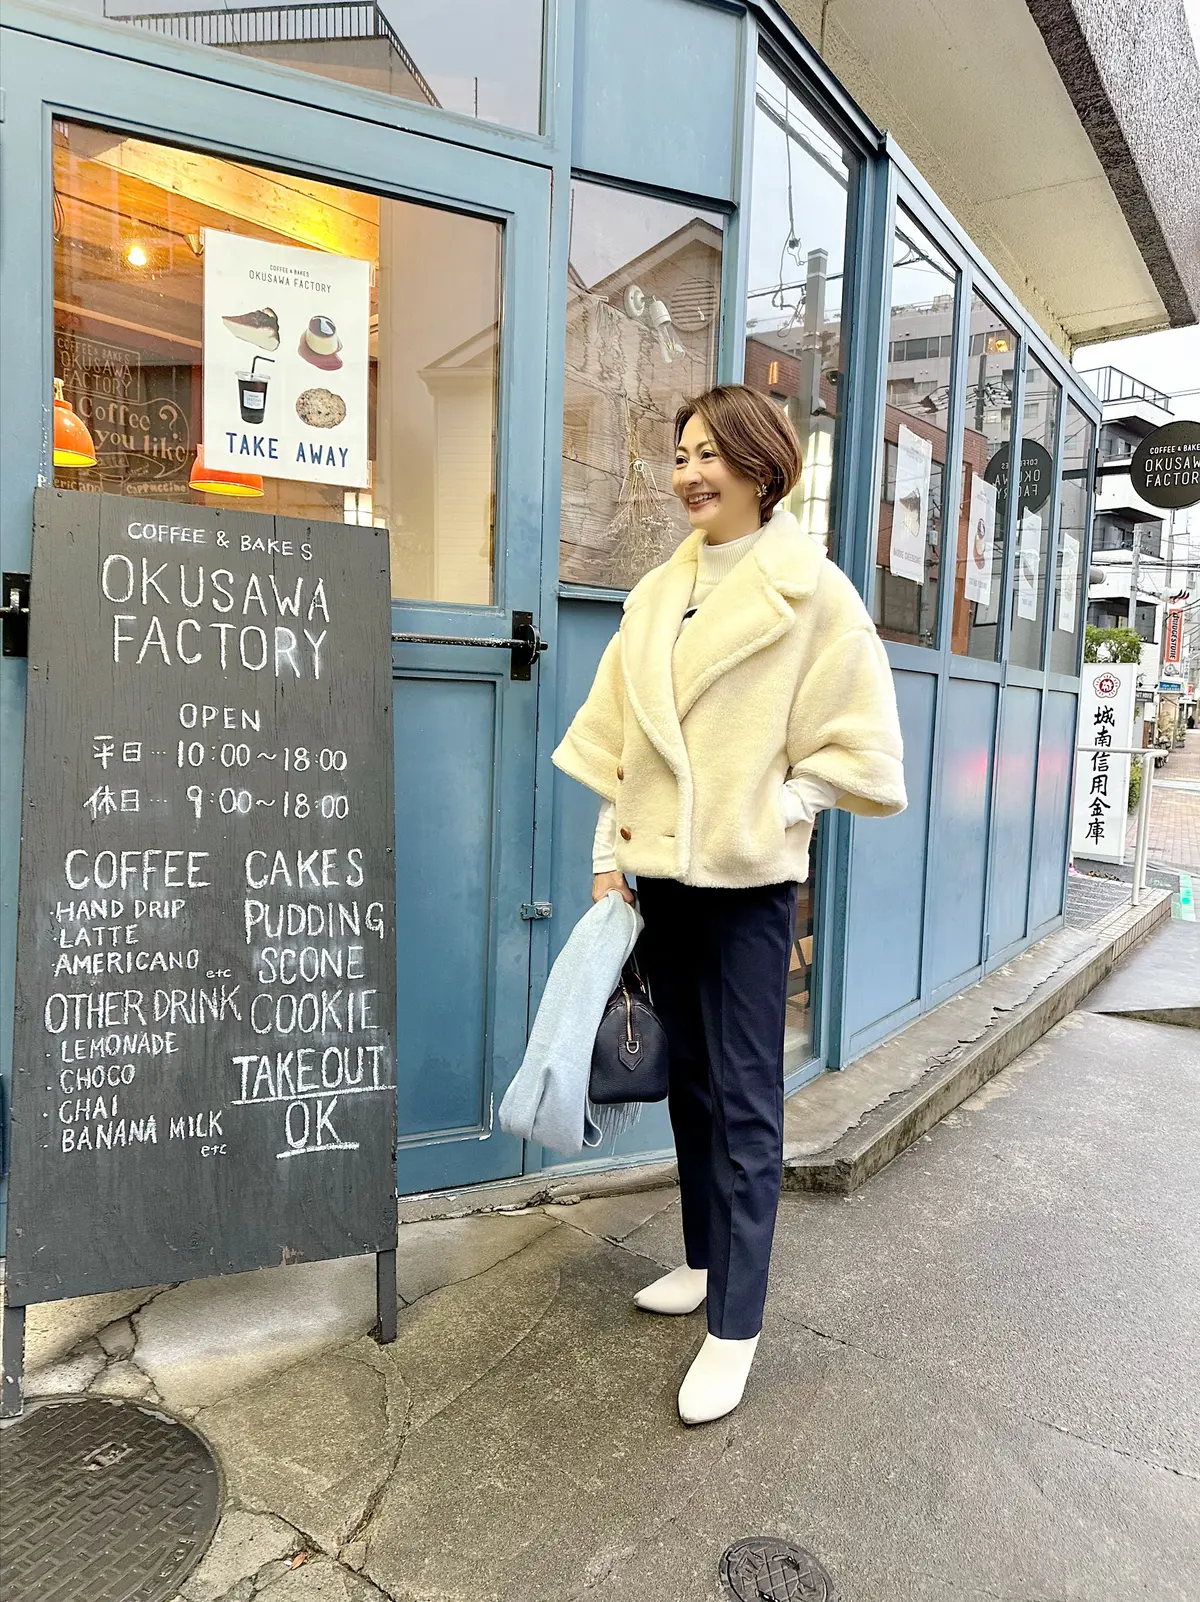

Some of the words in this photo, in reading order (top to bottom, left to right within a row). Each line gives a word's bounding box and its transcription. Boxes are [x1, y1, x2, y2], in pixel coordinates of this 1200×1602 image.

[249, 270, 290, 286] OKUSAWA
[293, 278, 331, 294] FACTORY
[269, 264, 289, 275] COFFEE
[293, 268, 310, 278] BAKES
[57, 337, 95, 356] COFFEE
[60, 350, 132, 381] OKUSAWA
[62, 367, 132, 398] FACTORY
[78, 396, 150, 431] Coffee
[94, 429, 135, 451] you
[143, 434, 186, 462] like
[226, 432, 279, 460] TAKE
[296, 442, 349, 468] AWAY
[1149, 445, 1176, 455] COFFEE
[1183, 443, 1200, 452] BAKE
[1145, 456, 1200, 473] OKUSAW
[1145, 471, 1200, 488] FACTOR
[127, 521, 207, 545] COFFEE
[216, 530, 230, 549] &
[240, 535, 313, 561] BAKES
[101, 553, 330, 624] OKUSAWA
[112, 613, 328, 680] FACTORY
[179, 703, 261, 732] OPEN
[92, 735, 143, 769] 平日
[1085, 704, 1115, 845] 城南信用金庫
[82, 785, 140, 819] 休日
[65, 848, 211, 891] COFFEE
[245, 847, 364, 889] CAKES
[54, 899, 124, 920] HAND
[135, 898, 186, 919] DRIP
[245, 898, 384, 944] PUDDING
[58, 924, 139, 948] LATTE
[54, 948, 200, 977] AMERICANO
[206, 966, 232, 980] etc
[258, 945, 365, 985] SCONE
[43, 988, 147, 1034] OTHER
[153, 984, 243, 1024] DRINK
[250, 988, 381, 1035] COOKIE
[61, 1031, 179, 1063] LEMONADE
[59, 1064, 136, 1094] CHOCO
[58, 1095, 118, 1124] CHAI
[284, 1095, 346, 1149] OK
[61, 1113, 158, 1153] BANANA
[169, 1110, 224, 1141] MILK
[200, 1143, 228, 1158] etc
